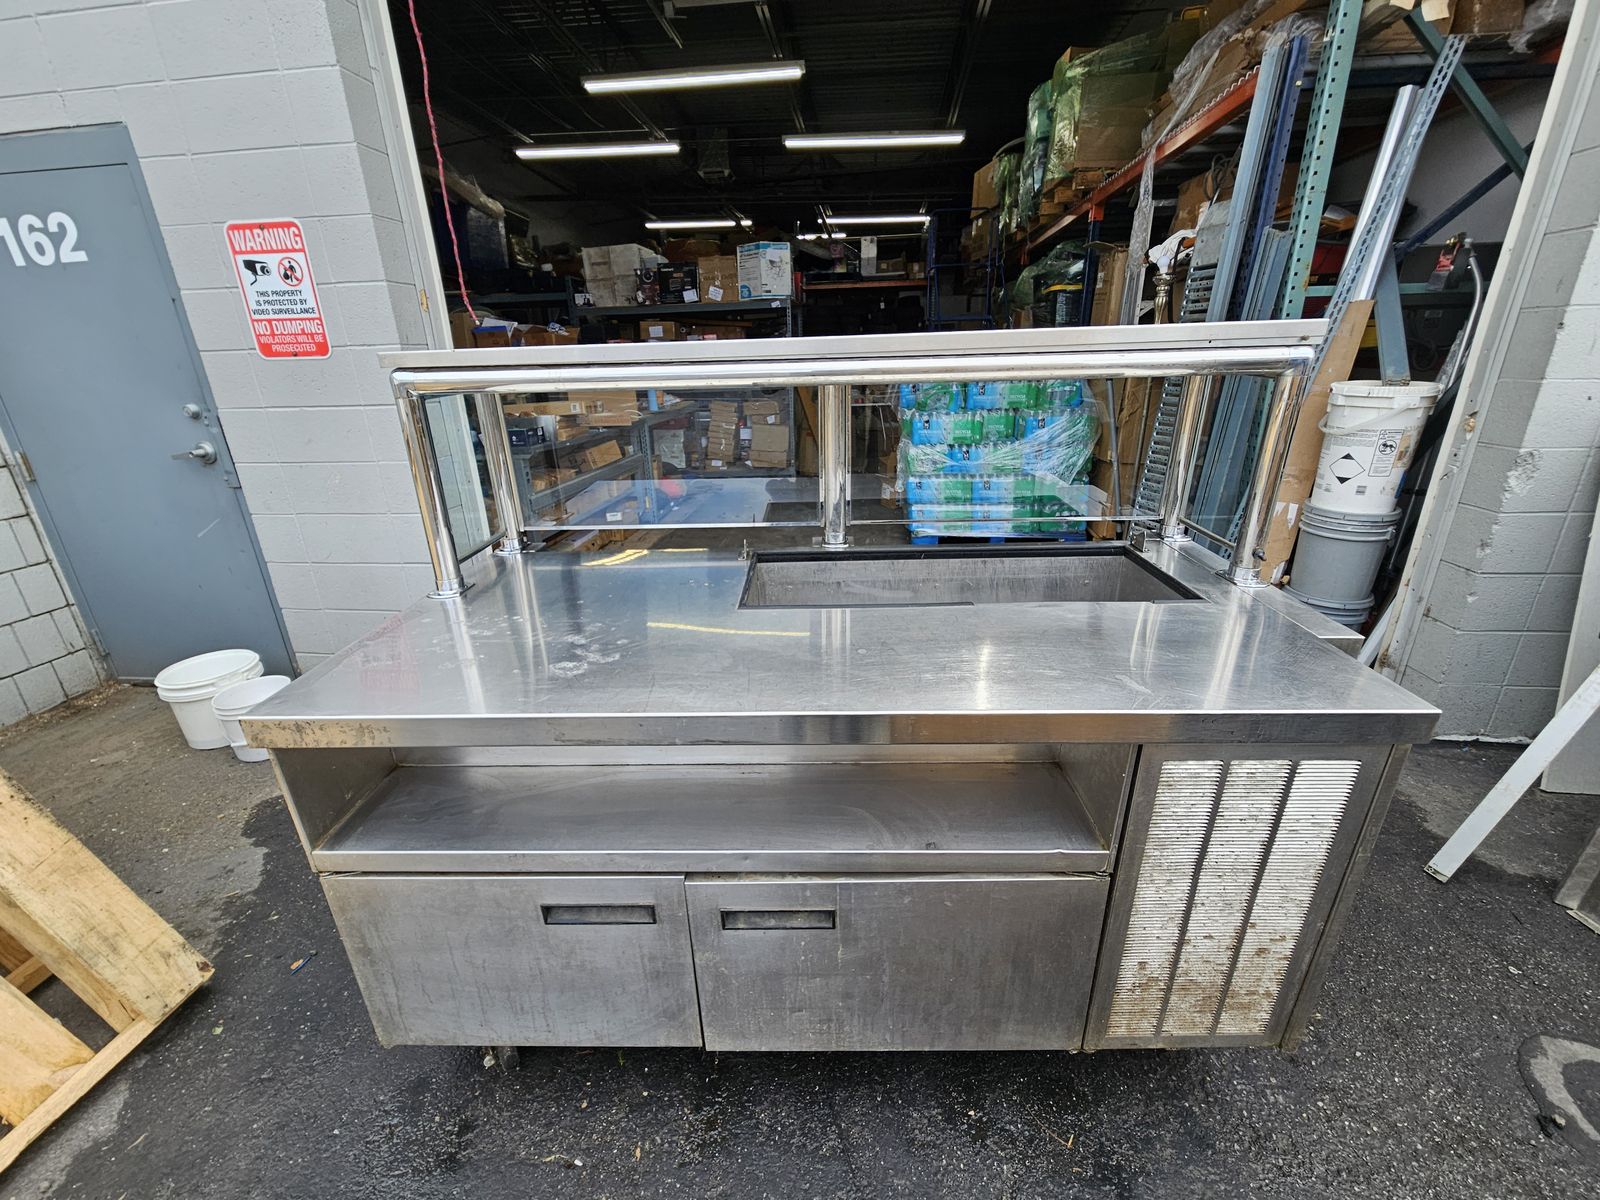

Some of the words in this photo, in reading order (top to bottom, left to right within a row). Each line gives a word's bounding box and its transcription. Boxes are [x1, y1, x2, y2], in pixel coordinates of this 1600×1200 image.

[0, 211, 88, 267] 162
[229, 228, 302, 251] WARNING
[255, 290, 270, 298] THIS
[270, 289, 303, 297] PROPERTY
[251, 308, 270, 316] VIDEO
[271, 307, 316, 315] SURVEILLANCE
[254, 321, 270, 335] NO
[272, 320, 323, 334] DUMPING
[260, 335, 295, 344] VIOLATORS
[295, 334, 314, 343] WILL
[314, 334, 325, 343] BE
[271, 343, 316, 352] PROSECUTED
